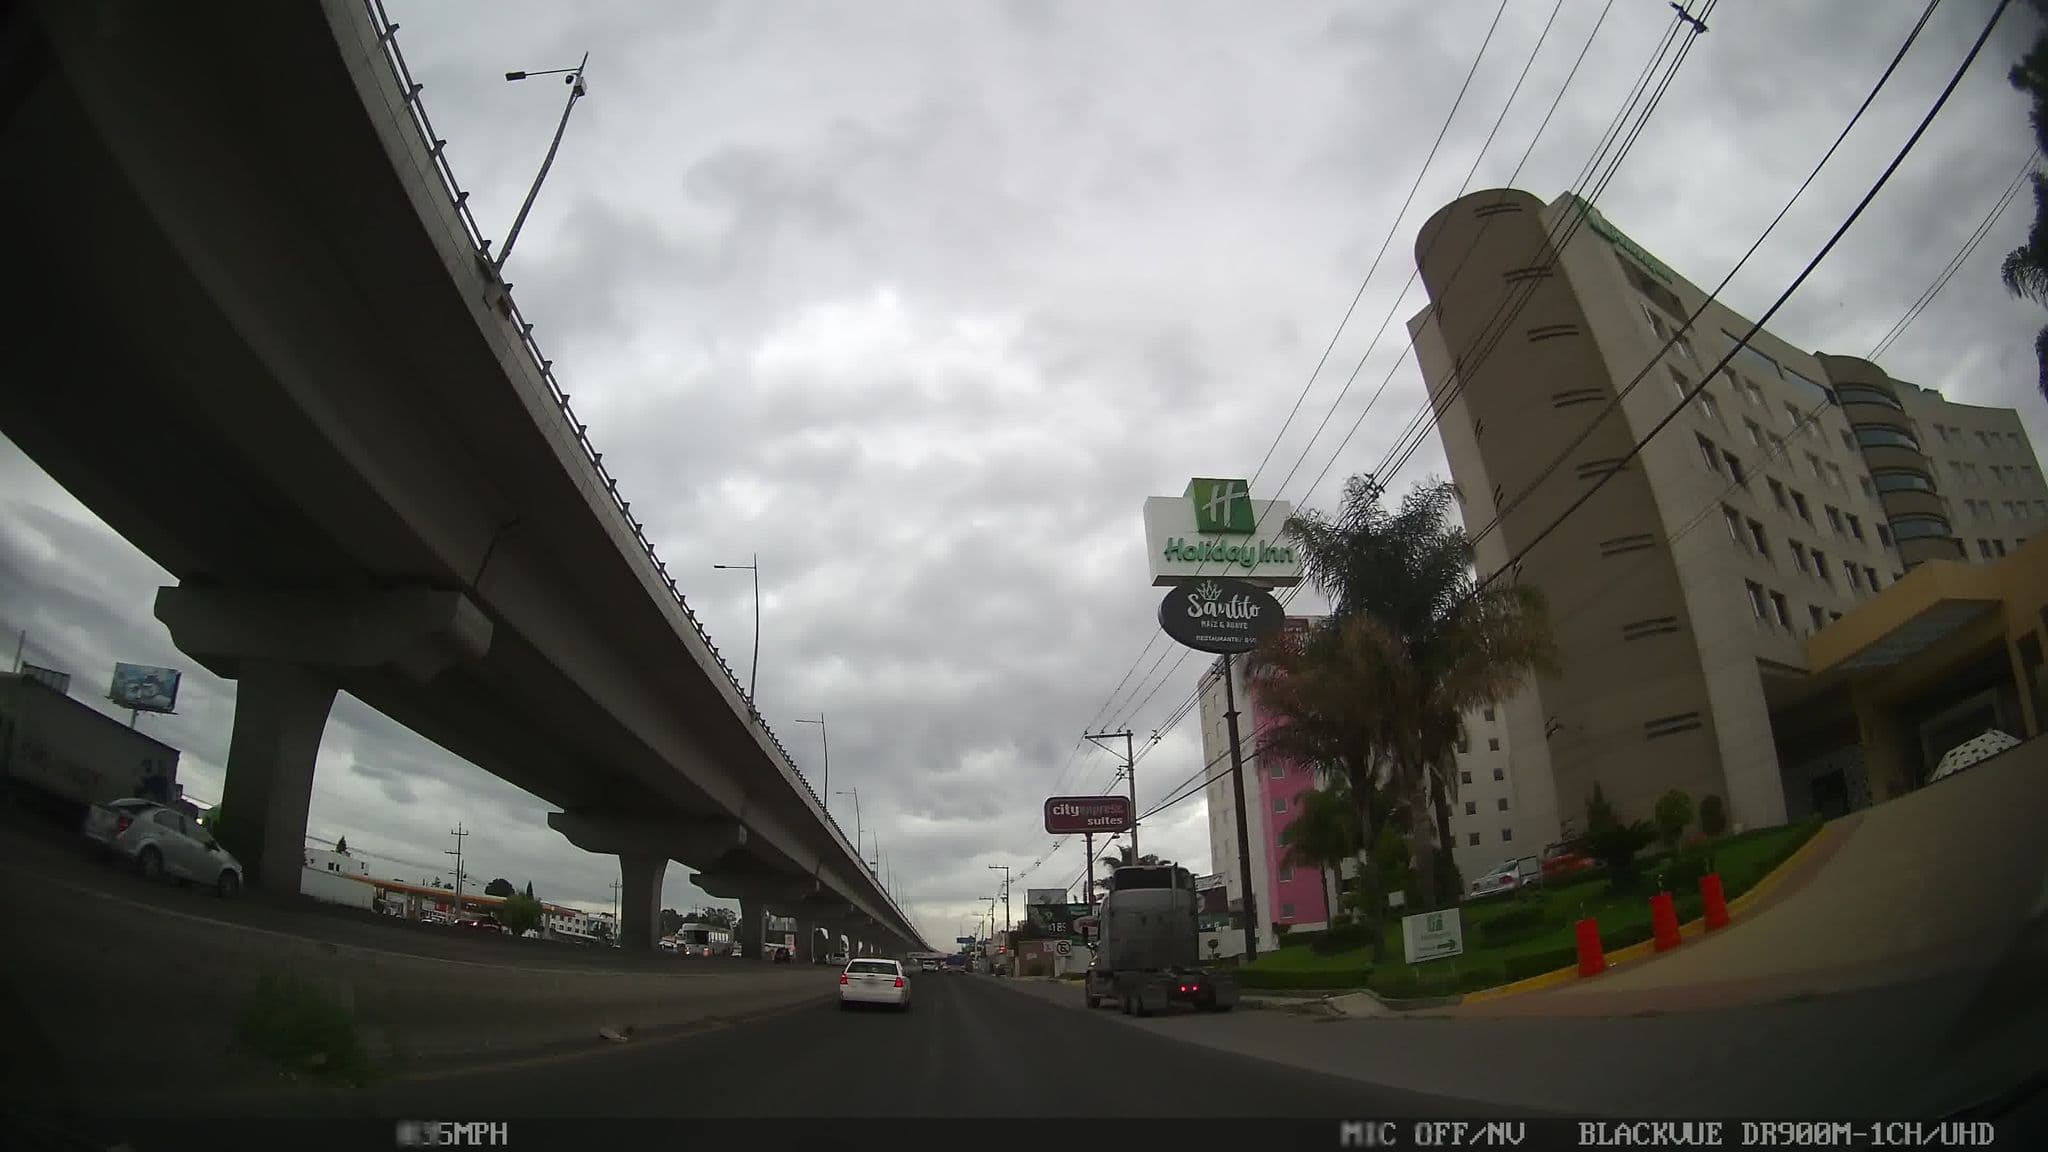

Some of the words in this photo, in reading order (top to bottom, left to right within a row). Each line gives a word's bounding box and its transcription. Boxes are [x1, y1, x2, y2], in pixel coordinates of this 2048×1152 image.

[1164, 537, 1255, 568] Holiday
[1259, 540, 1294, 563] Inn
[1088, 816, 1123, 825] suites
